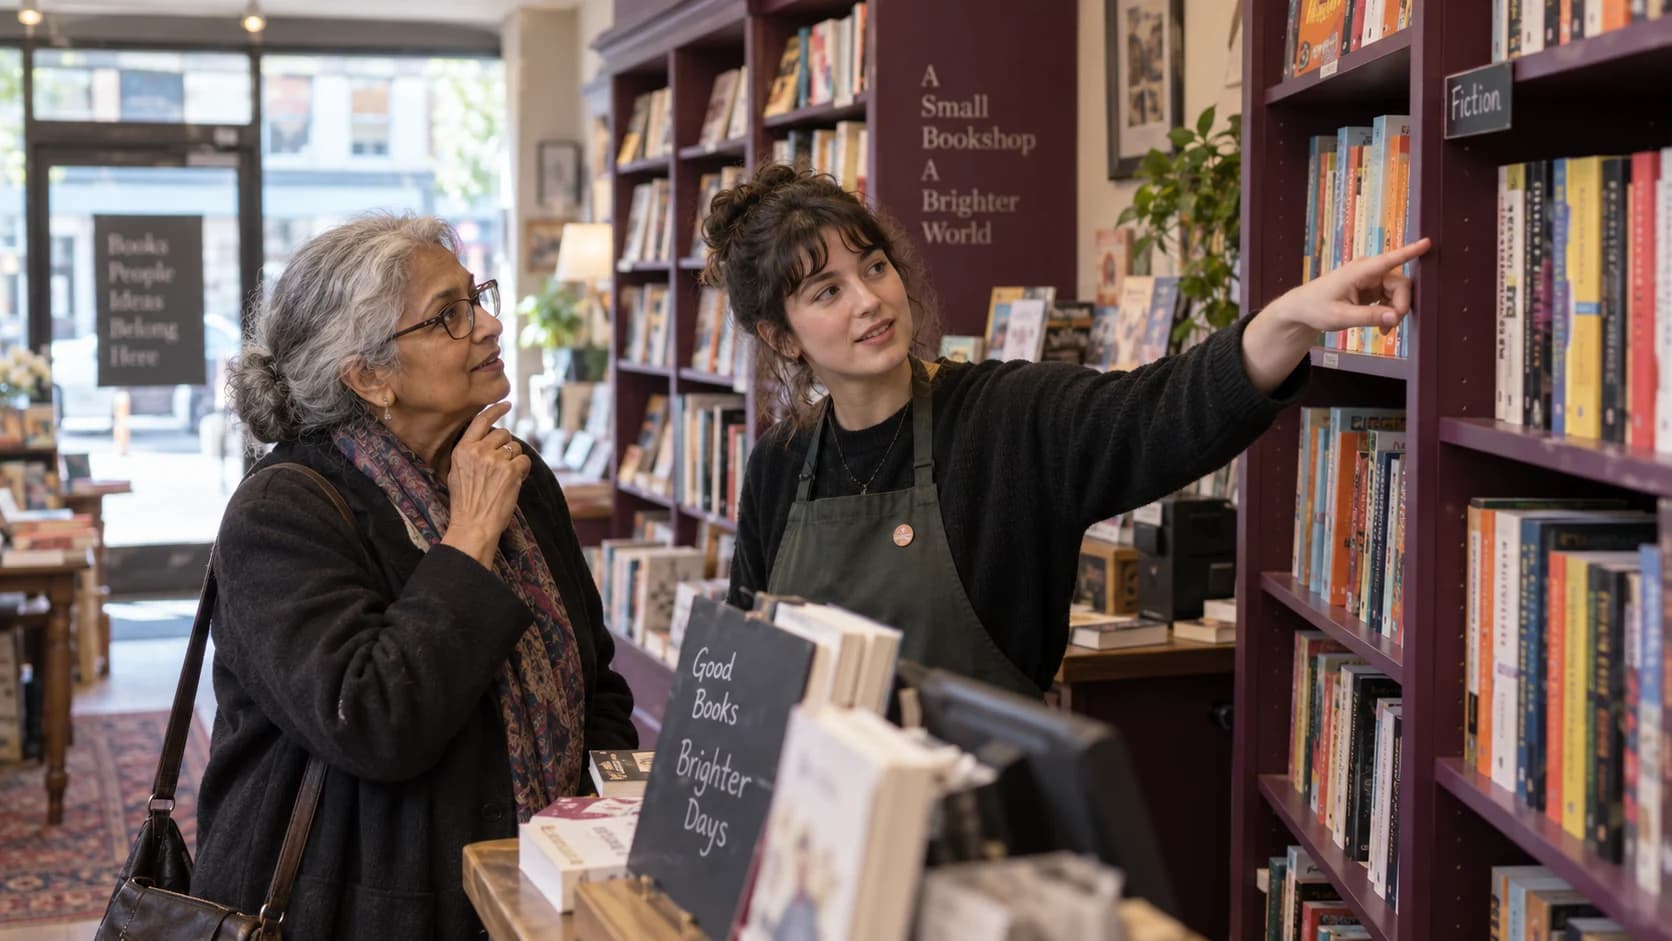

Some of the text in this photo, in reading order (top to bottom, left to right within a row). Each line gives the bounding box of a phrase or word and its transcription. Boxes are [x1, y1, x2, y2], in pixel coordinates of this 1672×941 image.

[921, 64, 940, 87] A
[921, 94, 988, 118] Small
[1452, 83, 1502, 120] Fiction
[922, 126, 1036, 156] Bookshop
[921, 158, 940, 181] A
[922, 188, 1020, 218] Brighter
[108, 232, 168, 255] Books
[921, 221, 991, 244] World
[109, 260, 175, 287] People
[110, 289, 164, 311] Ideas
[110, 315, 179, 343] Belong
[110, 344, 160, 367] Here
[692, 647, 736, 682] Good
[692, 688, 738, 725] Books
[676, 738, 752, 798] Brighter
[684, 798, 728, 856] Days
